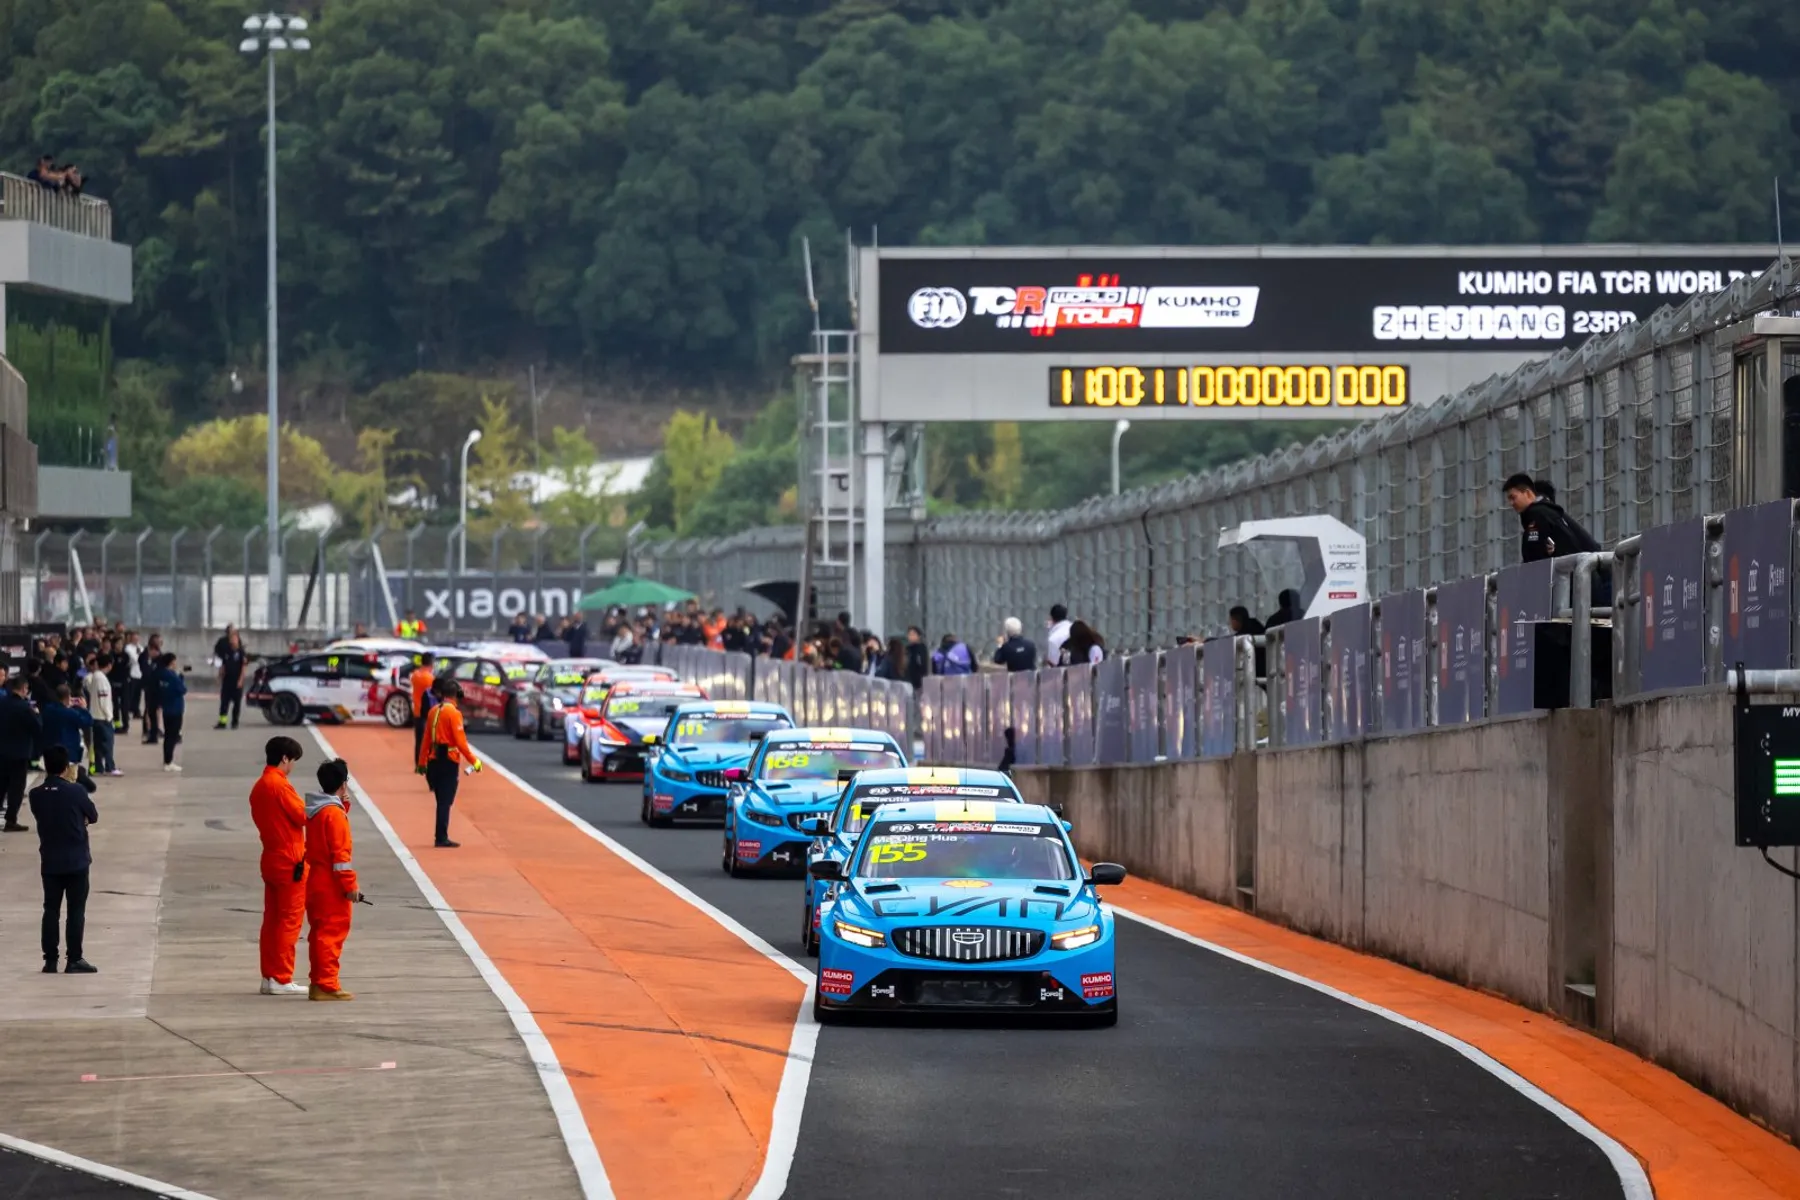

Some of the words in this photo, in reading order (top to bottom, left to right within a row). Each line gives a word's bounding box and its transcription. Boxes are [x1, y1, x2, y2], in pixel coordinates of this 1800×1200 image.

[1458, 270, 1551, 294] KUMHO
[1557, 271, 1598, 294] FIA
[1601, 271, 1650, 294] TCR
[911, 292, 964, 323] FIA
[969, 286, 1047, 315] TCR
[1158, 296, 1242, 308] KUMHO
[1062, 307, 1135, 325] TOUR
[1204, 309, 1241, 318] TIRE
[1379, 310, 1562, 334] ZHEJIANG
[766, 755, 809, 769] 168
[869, 843, 927, 863] 155
[822, 970, 853, 981] KUMHO
[1082, 974, 1112, 985] KUMHO
